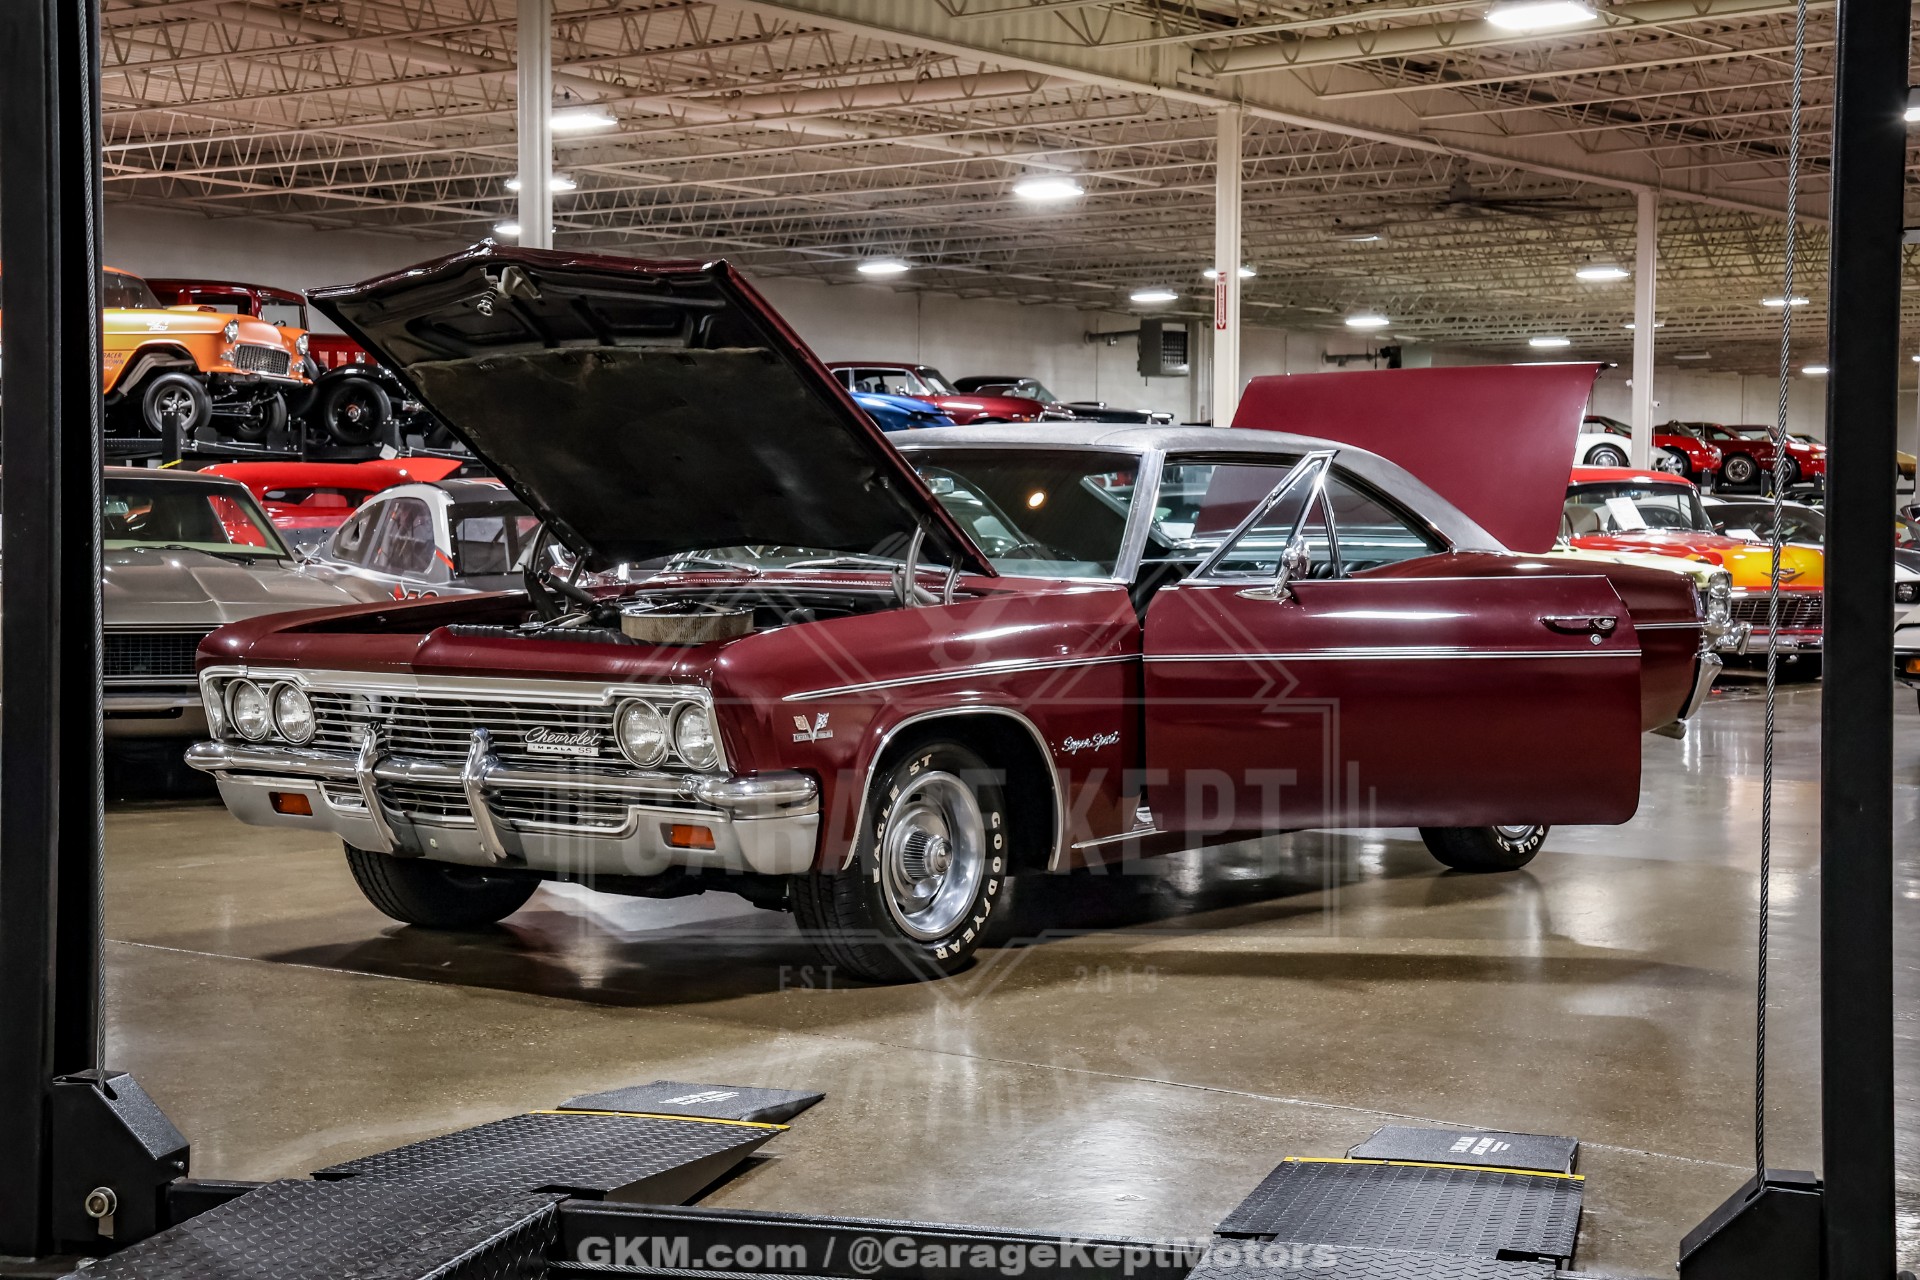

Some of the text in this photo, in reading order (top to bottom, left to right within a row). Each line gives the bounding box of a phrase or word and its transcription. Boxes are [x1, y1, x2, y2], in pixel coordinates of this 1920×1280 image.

[525, 726, 601, 746] Chevrolet
[1061, 731, 1120, 756] Super Sport
[871, 753, 932, 884] EAGLE ST
